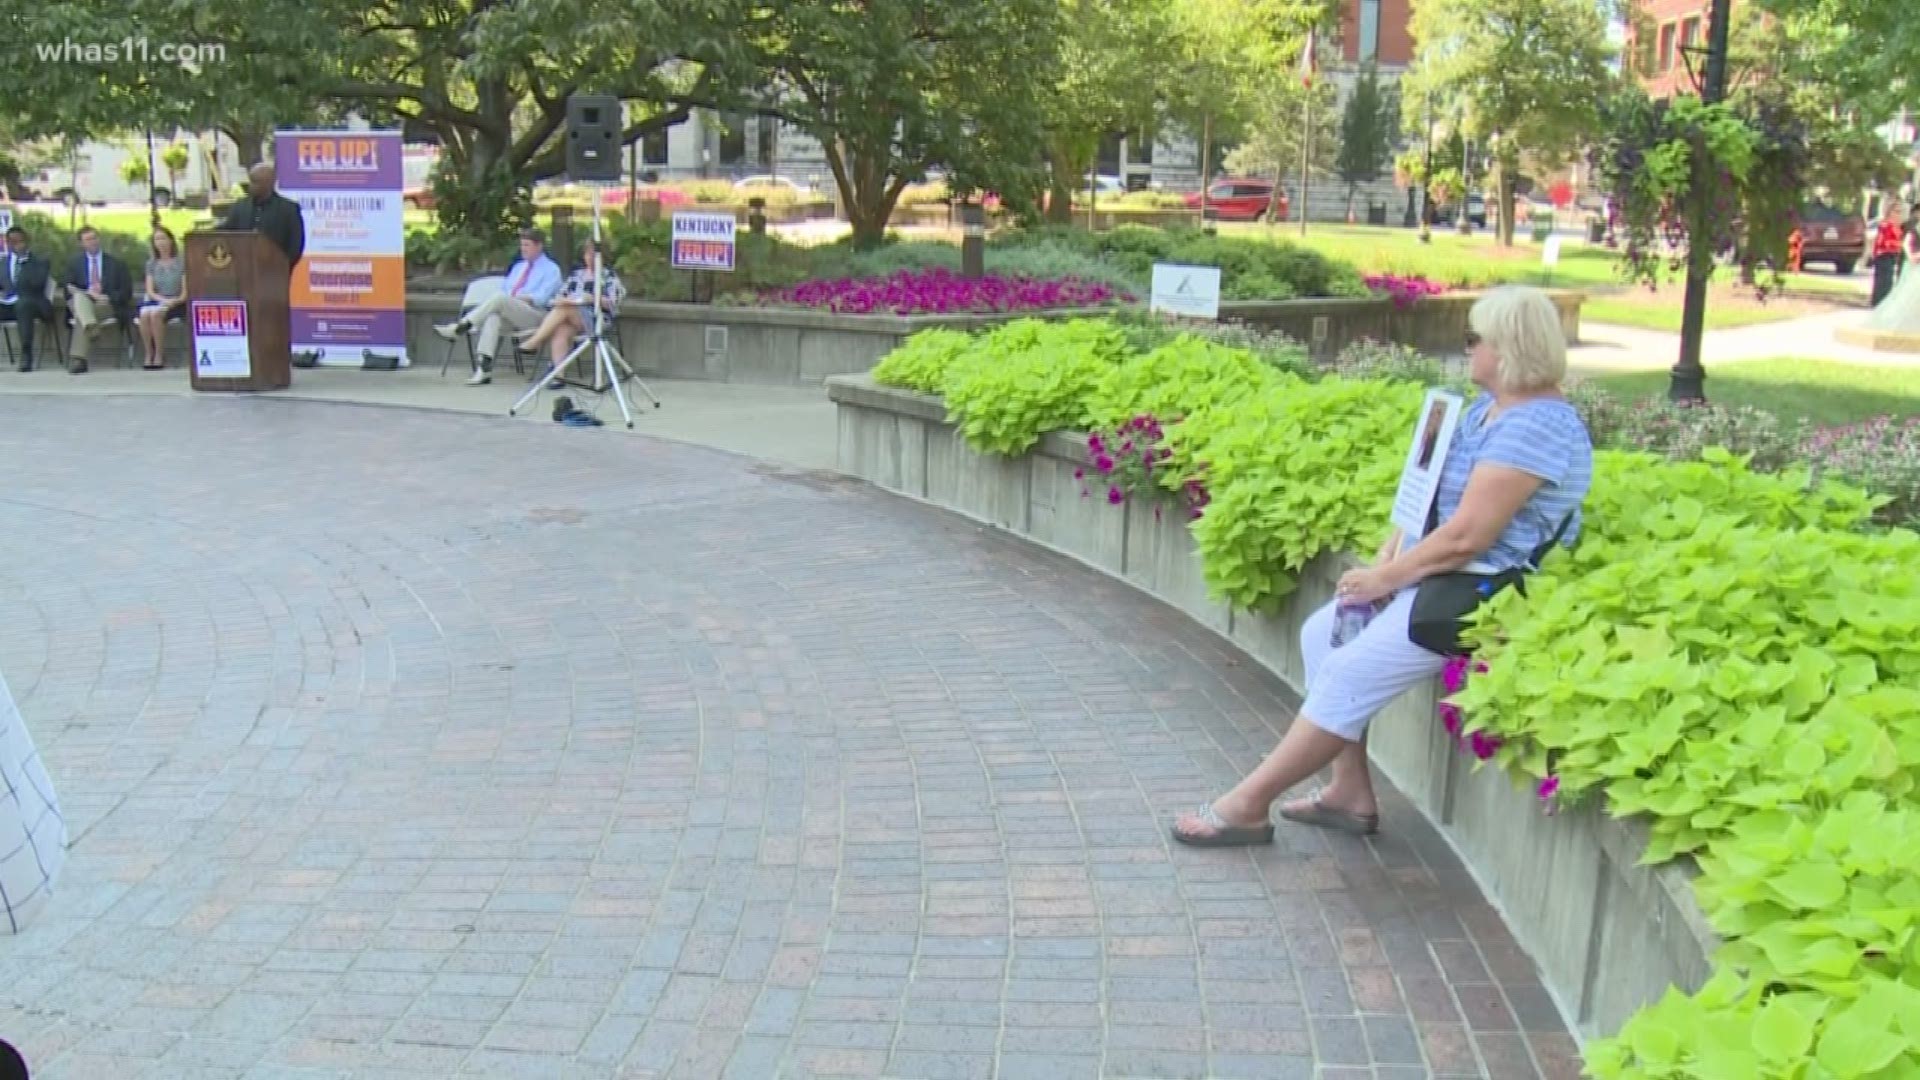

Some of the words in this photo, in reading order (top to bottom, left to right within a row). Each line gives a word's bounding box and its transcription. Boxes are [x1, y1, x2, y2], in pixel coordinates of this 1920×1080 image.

[298, 139, 337, 169] FED
[340, 139, 379, 170] UP!
[675, 218, 732, 234] KENTUCKY
[678, 242, 702, 263] FED
[704, 243, 728, 264] UP!
[197, 305, 220, 331] FED
[220, 305, 242, 332] UP!
